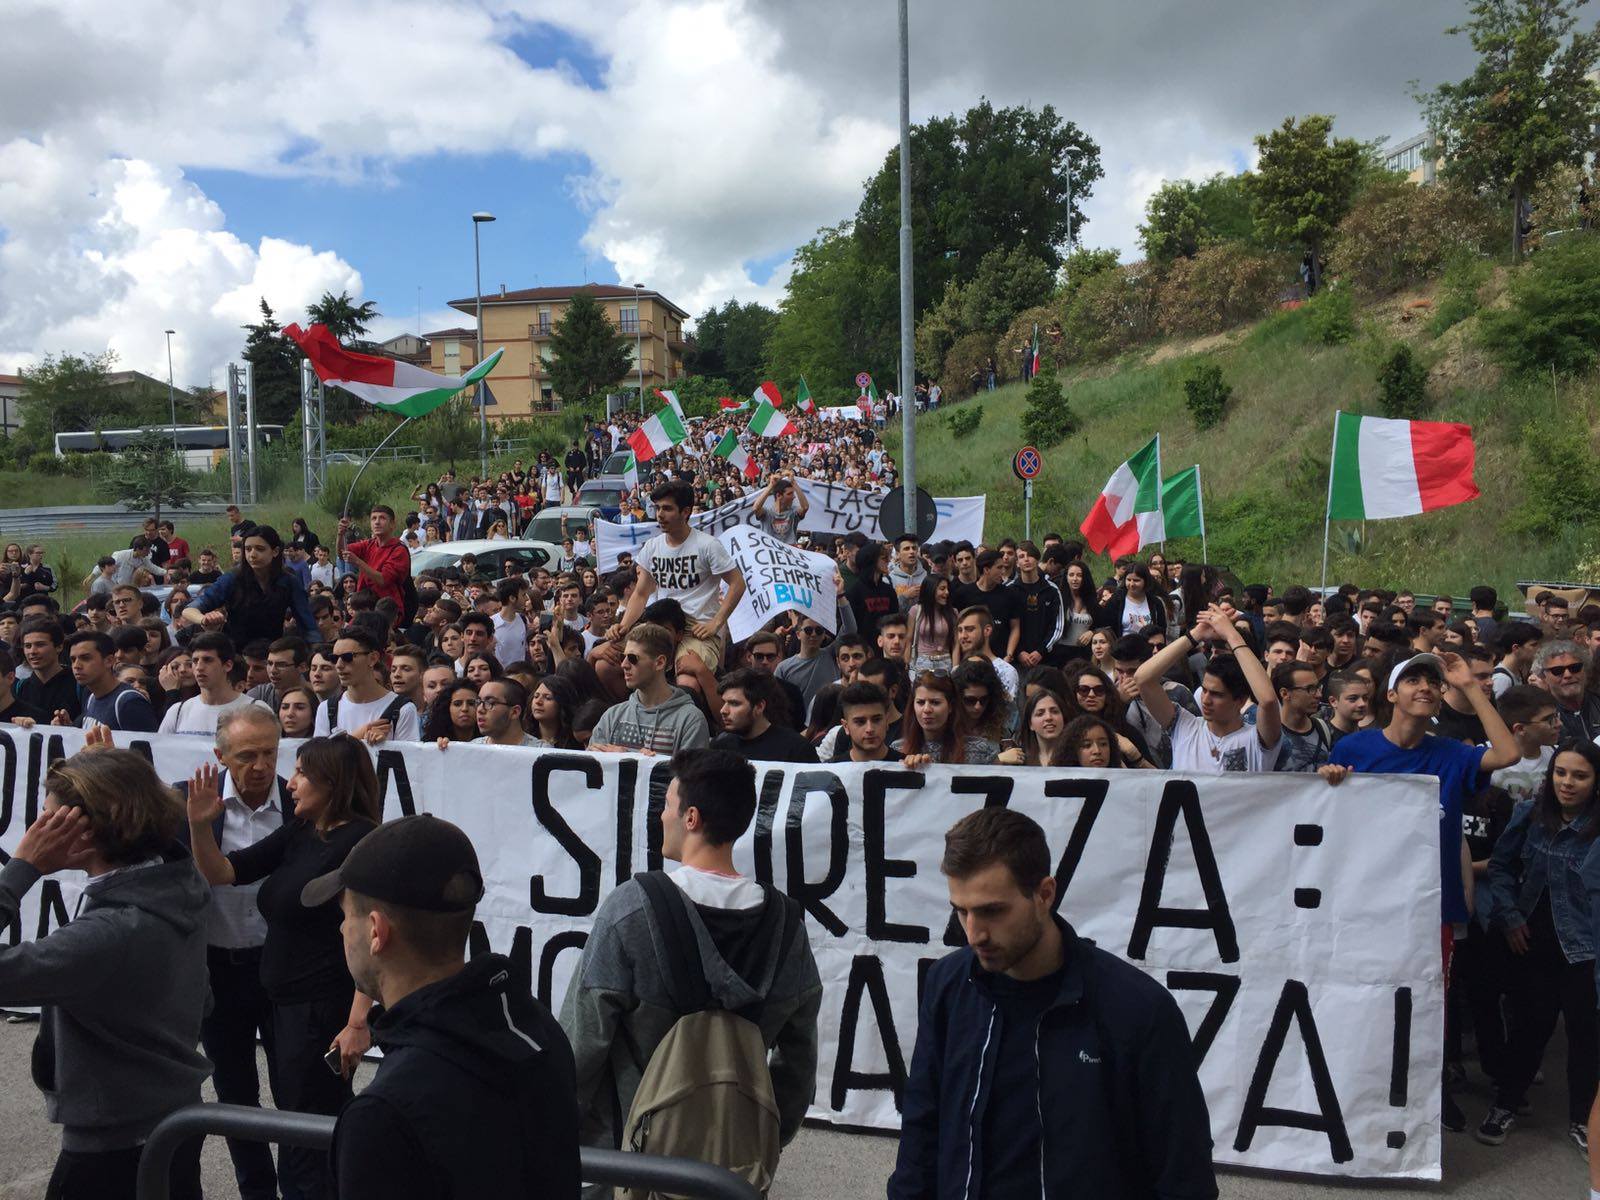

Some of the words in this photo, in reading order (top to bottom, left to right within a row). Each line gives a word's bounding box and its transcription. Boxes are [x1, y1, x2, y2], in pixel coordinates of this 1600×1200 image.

[730, 536, 742, 556] A
[652, 555, 698, 574] SUNSET
[755, 549, 809, 570] CIELO
[653, 572, 700, 590] BEACH
[759, 567, 822, 595] SEMPRE
[774, 583, 812, 609] BLU
